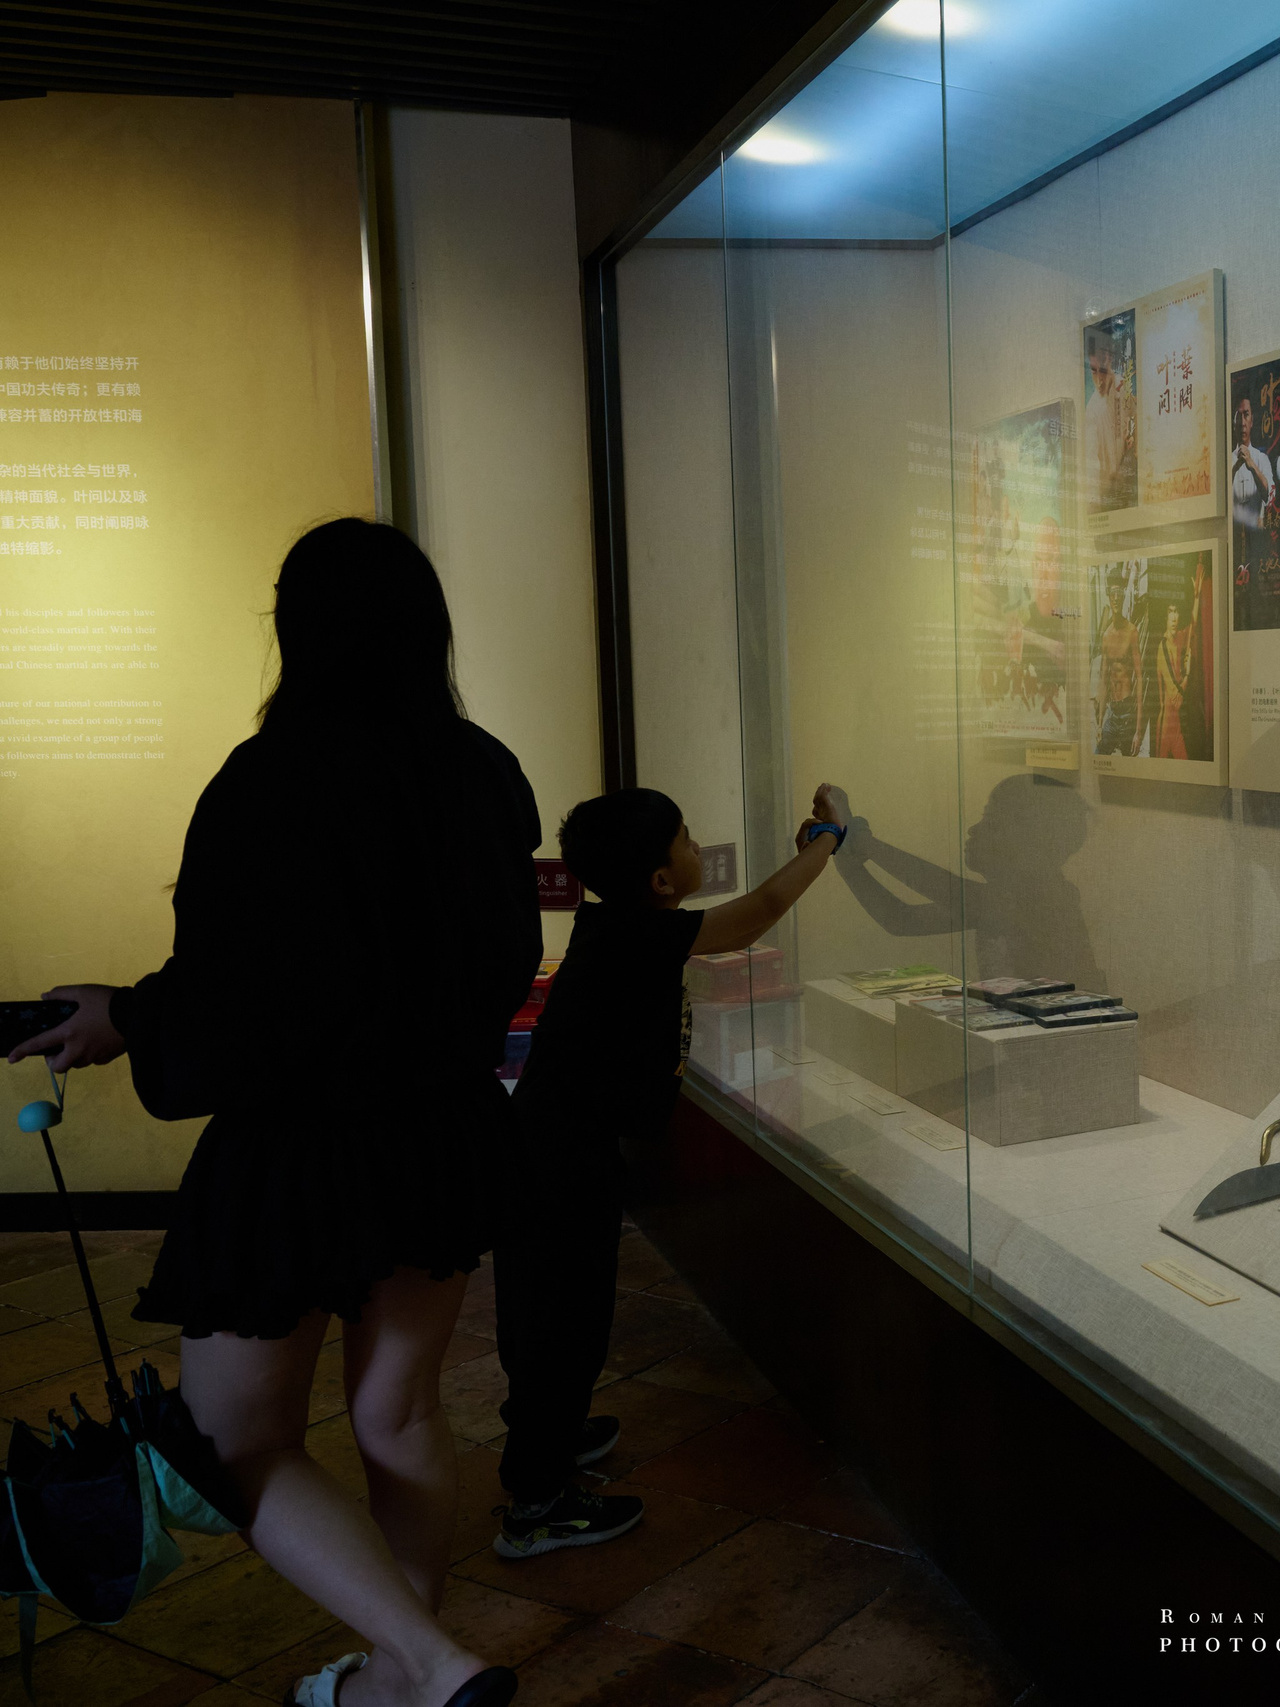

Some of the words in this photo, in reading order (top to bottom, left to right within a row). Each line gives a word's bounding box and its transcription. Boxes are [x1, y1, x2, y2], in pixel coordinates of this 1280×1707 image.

[0, 356, 139, 371] 赖于他们始终坚持开
[0, 489, 148, 504] 精神面貌。叶问以及咏
[1, 515, 149, 530] 重大贡献，同时阐明咏
[3, 626, 54, 634] world-class
[57, 626, 89, 634] martial
[111, 626, 132, 634] With
[136, 626, 156, 634] their
[8, 734, 30, 742] vivid
[33, 734, 71, 744] example
[74, 734, 84, 742] of
[93, 735, 119, 744] group
[134, 734, 163, 744] people
[7, 751, 49, 760] followers
[87, 751, 141, 759] demonstrate
[144, 751, 164, 759] their
